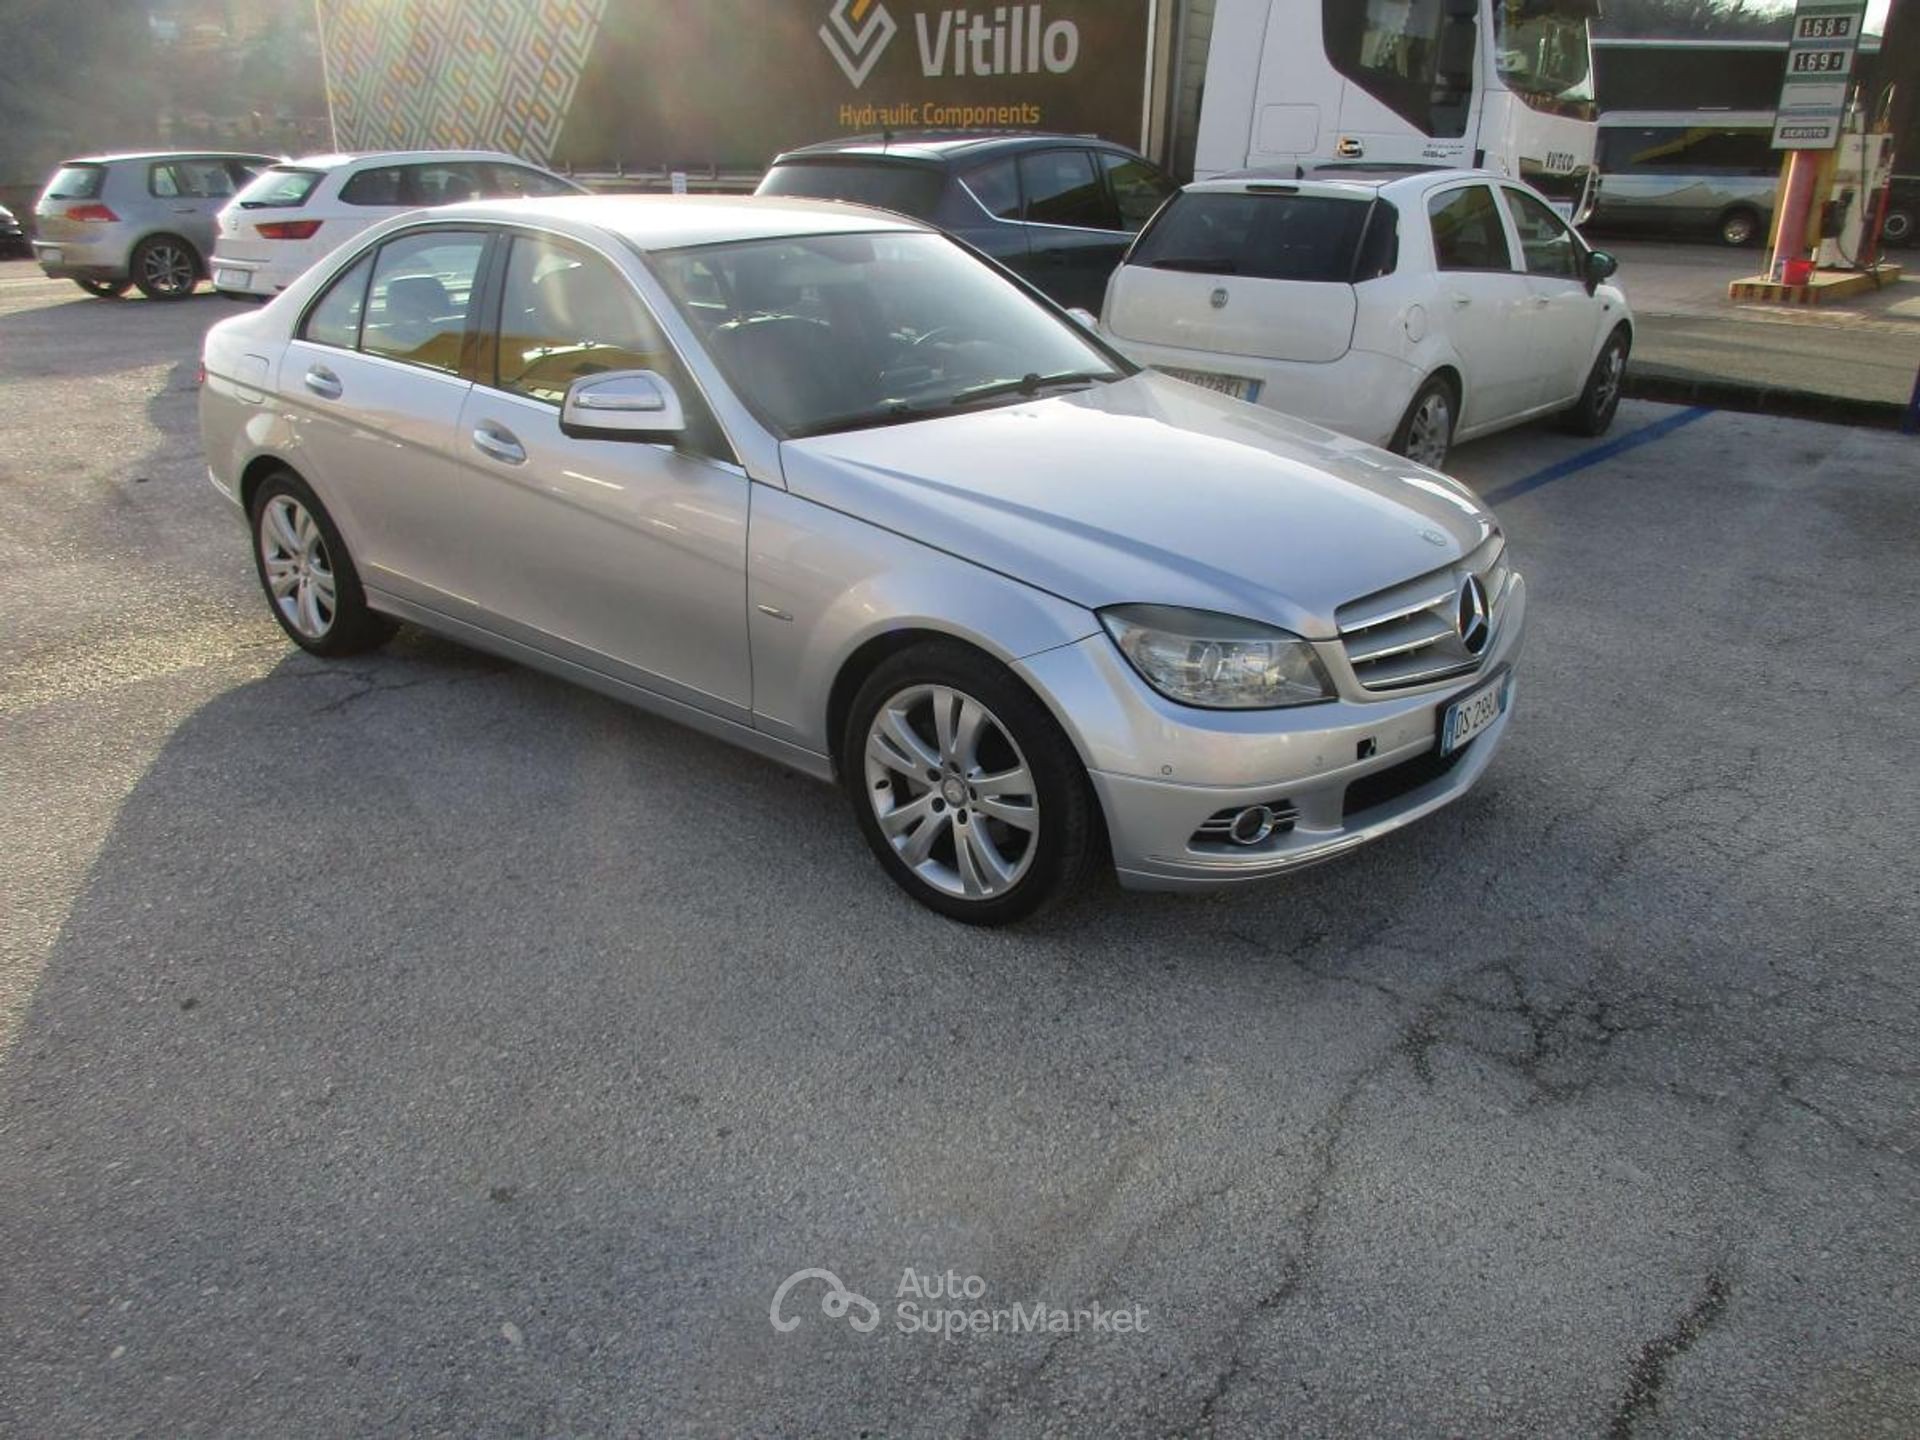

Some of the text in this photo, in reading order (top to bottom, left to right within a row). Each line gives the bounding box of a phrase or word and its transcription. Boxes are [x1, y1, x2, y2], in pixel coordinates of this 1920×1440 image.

[914, 5, 1079, 77] Vitillo
[839, 102, 1040, 128] Hydraulic Components
[1546, 151, 1575, 171] IVECO
